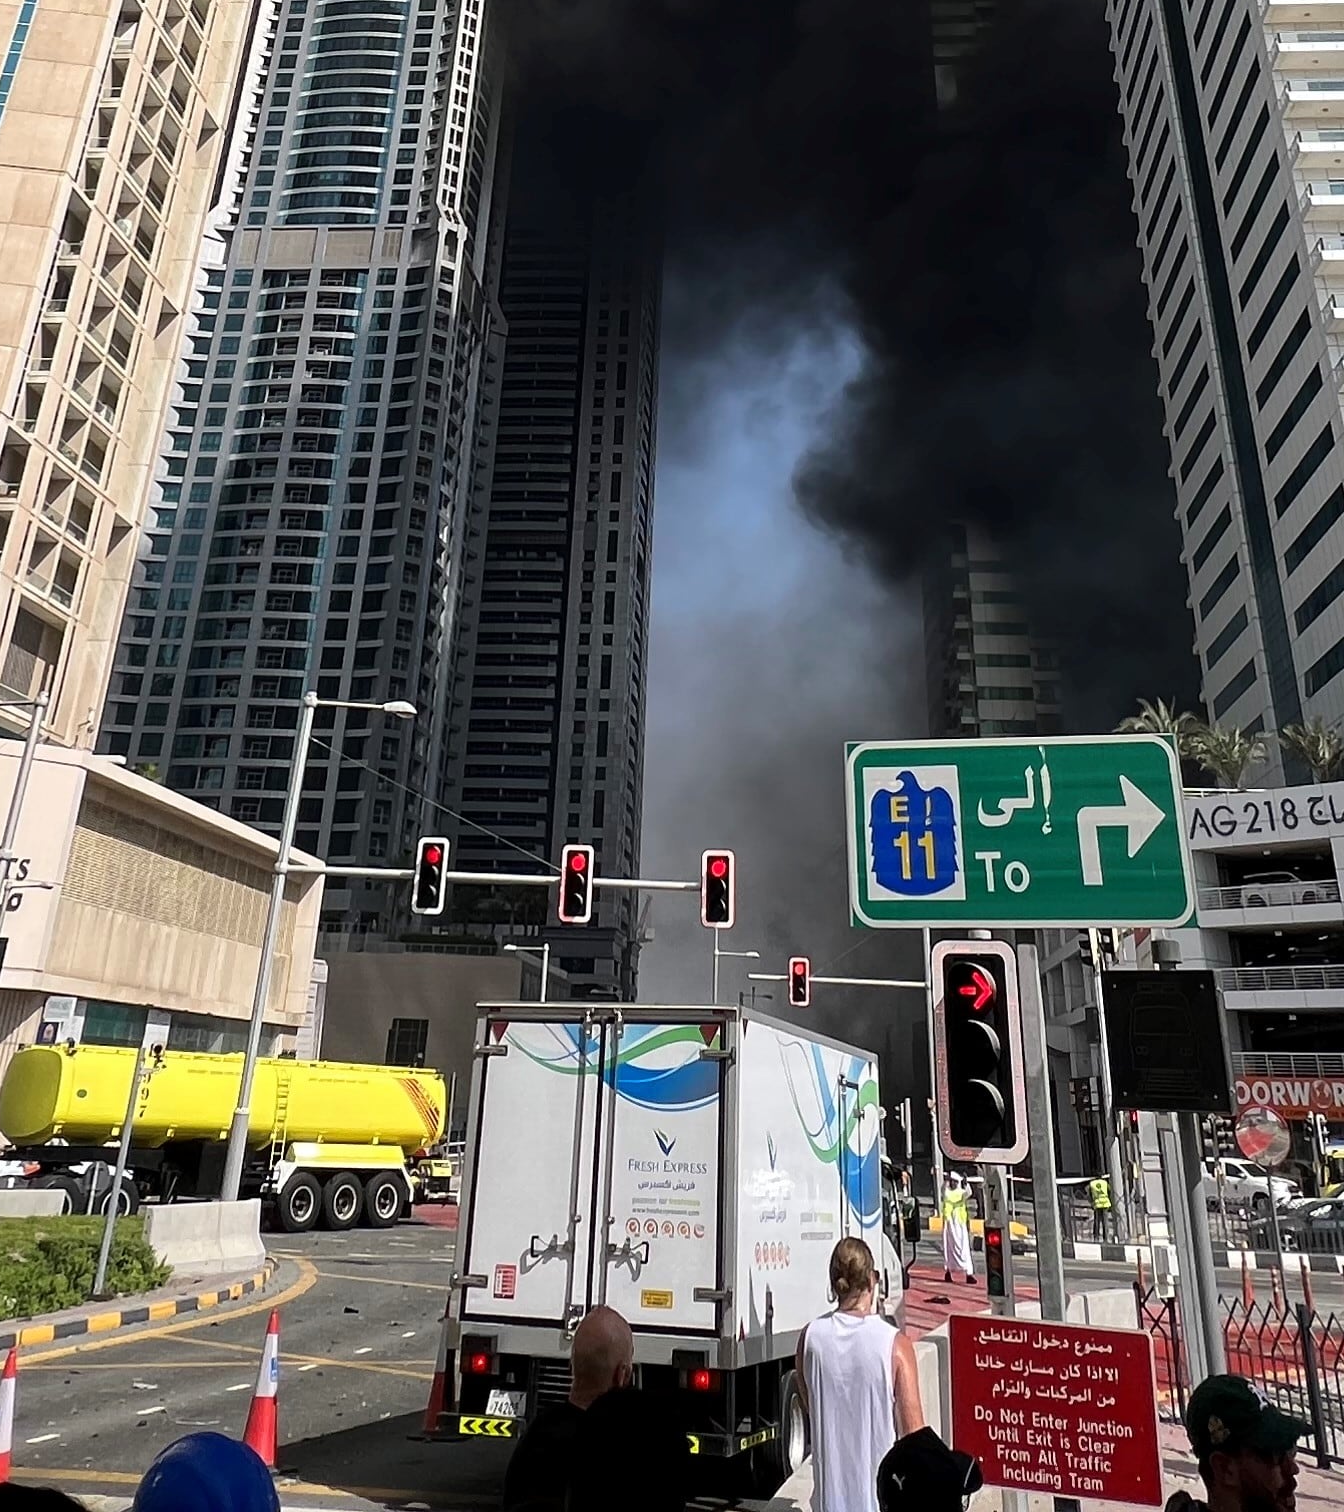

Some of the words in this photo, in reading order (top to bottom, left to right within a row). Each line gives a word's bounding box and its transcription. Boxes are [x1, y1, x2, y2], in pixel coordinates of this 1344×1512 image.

[977, 746, 1052, 835] إلى
[890, 797, 910, 823] E
[1189, 805, 1238, 840] AG
[1243, 797, 1299, 834] 218
[894, 831, 936, 880] 11
[975, 851, 1031, 893] To
[628, 1158, 660, 1173] FRESH
[663, 1159, 708, 1175] EXPRESS
[1032, 1330, 1069, 1350] دخول
[1074, 1337, 1113, 1357] ممنوع
[975, 1353, 1006, 1371] خاليا
[1010, 1358, 1054, 1377] مسارك
[1059, 1364, 1081, 1380] كان
[992, 1378, 1031, 1399] والترام
[1035, 1385, 1092, 1405] المركبات
[1096, 1393, 1116, 1408] من
[974, 1405, 993, 1422] Do
[1000, 1408, 1025, 1426] Not
[1032, 1412, 1068, 1430] Enter
[1076, 1417, 1133, 1438] Junction
[988, 1424, 1020, 1444] Until
[1027, 1429, 1052, 1448] Exit
[1060, 1433, 1071, 1450] is
[1078, 1436, 1116, 1455] Clear
[997, 1444, 1031, 1463] From
[1065, 1452, 1112, 1473] Traffic
[1002, 1463, 1062, 1489] Including
[1069, 1472, 1104, 1491] Tram
